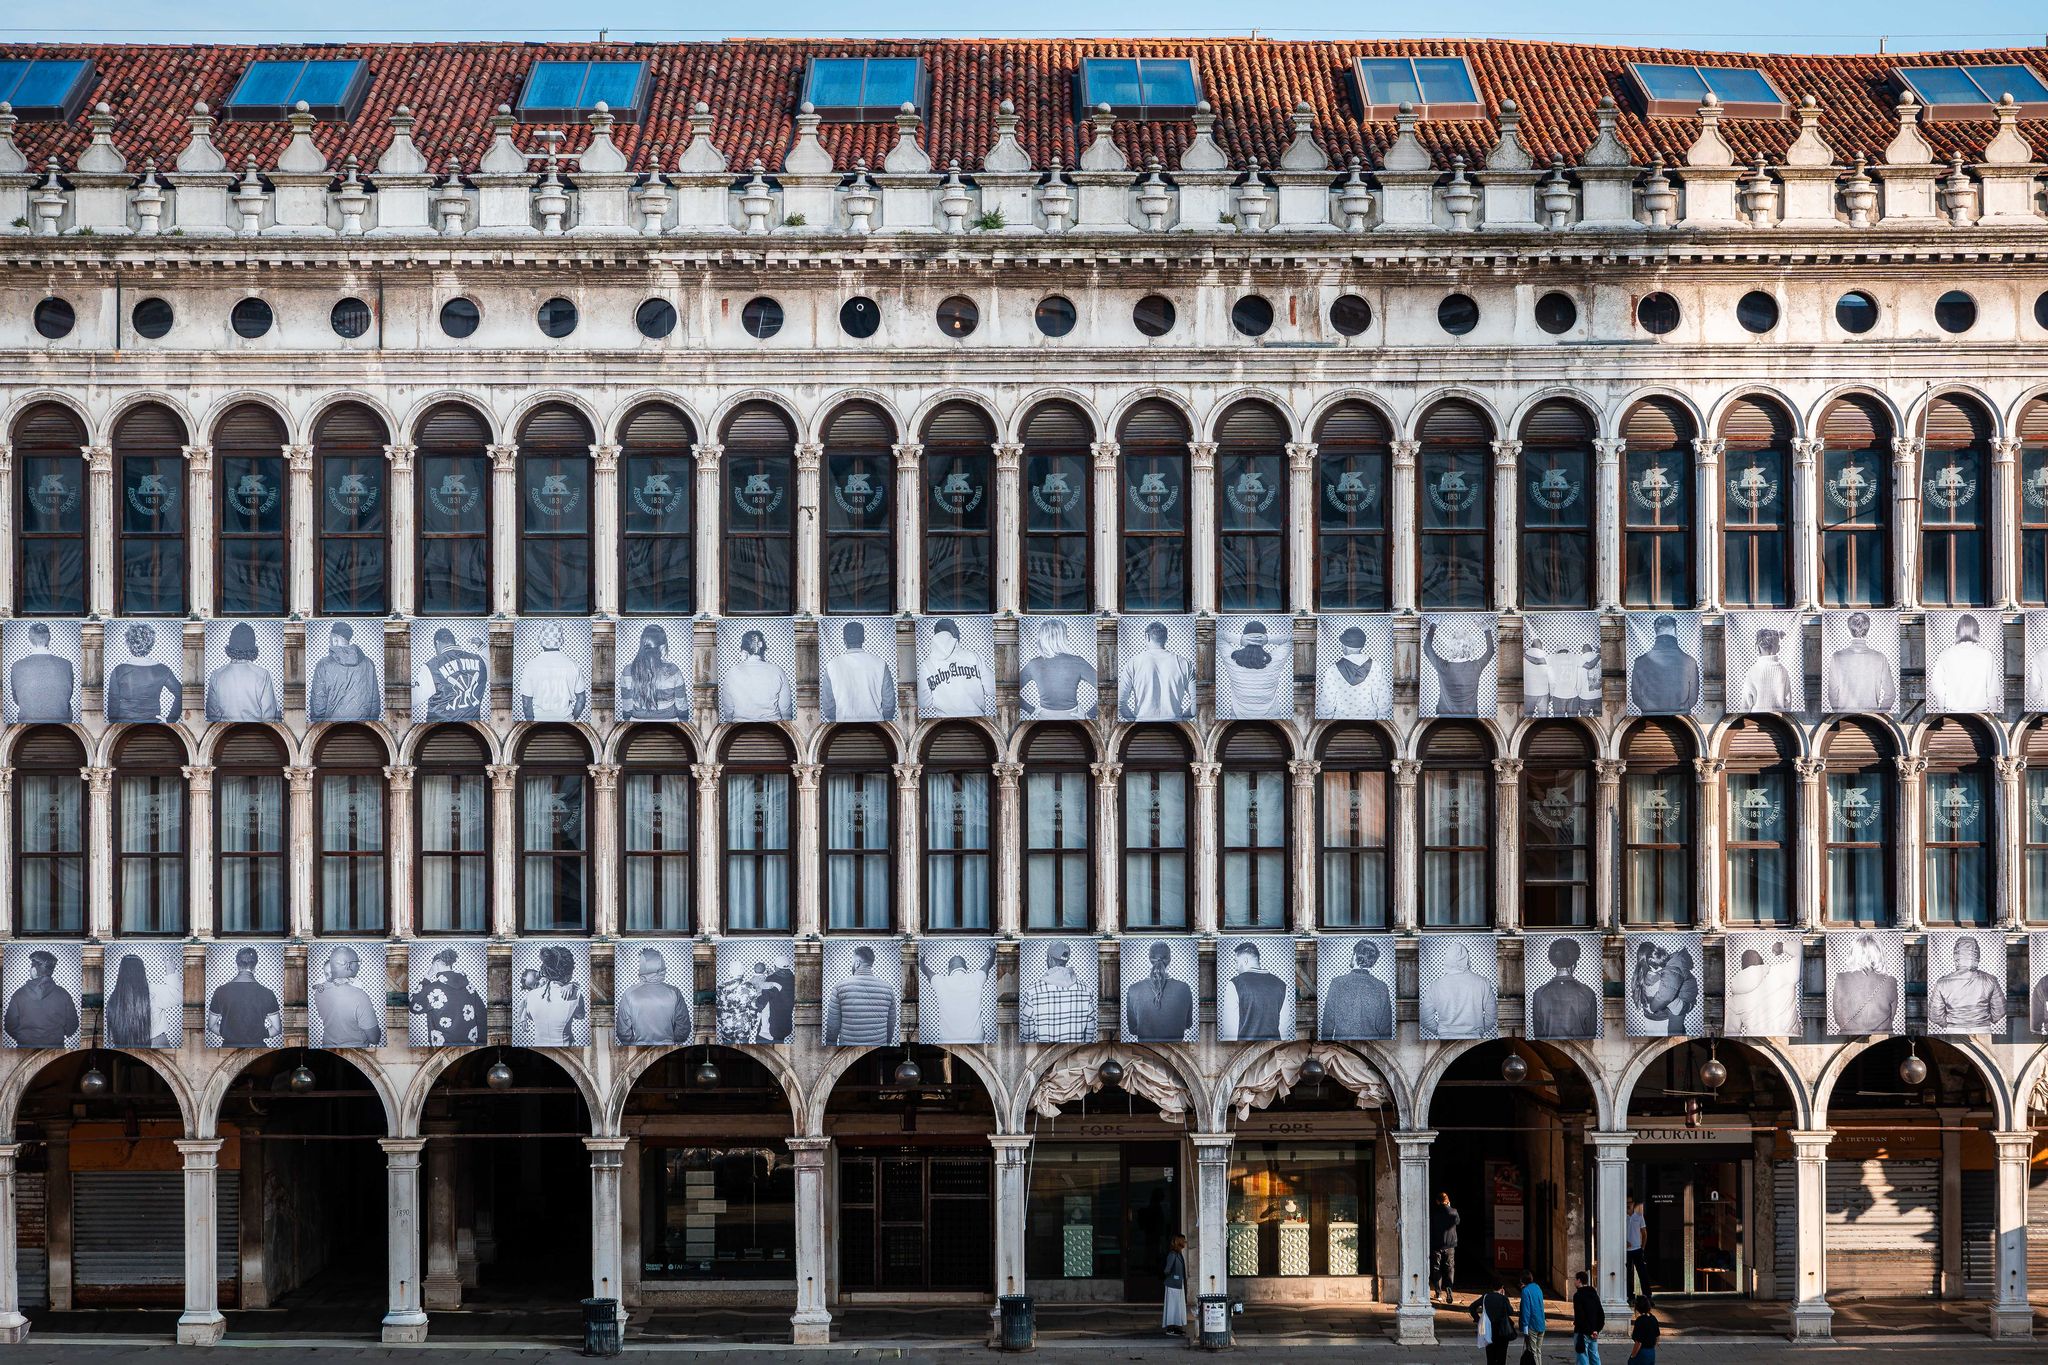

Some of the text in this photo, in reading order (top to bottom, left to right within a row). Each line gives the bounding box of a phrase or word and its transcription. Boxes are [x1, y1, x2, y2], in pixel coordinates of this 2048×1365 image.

[439, 658, 480, 678] NEW YORK
[927, 662, 981, 691] Baby Angel
[1081, 1125, 1124, 1136] FOPE
[1269, 1123, 1313, 1134] FOPE
[1634, 1128, 1716, 1140] OCURATIE
